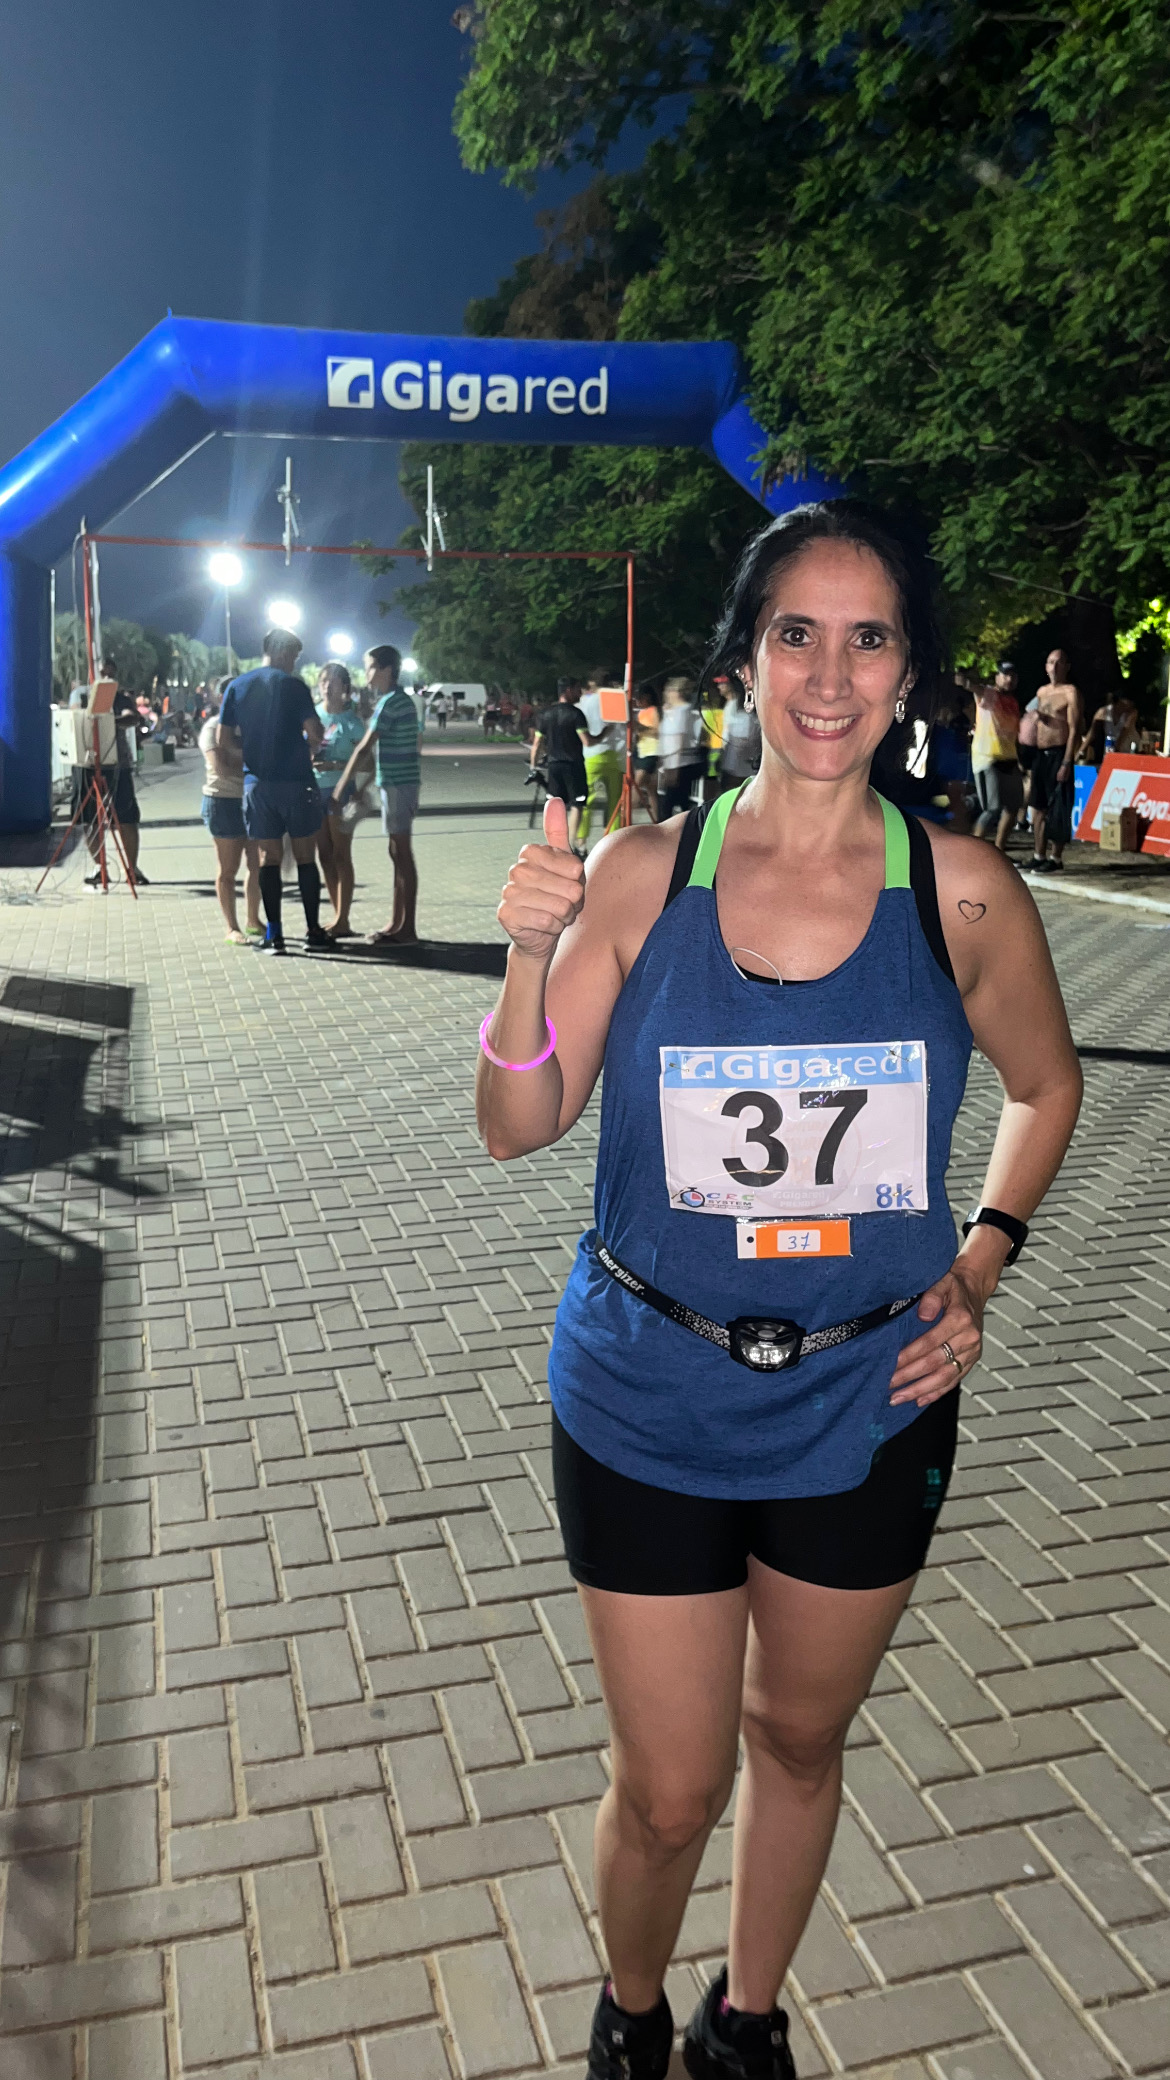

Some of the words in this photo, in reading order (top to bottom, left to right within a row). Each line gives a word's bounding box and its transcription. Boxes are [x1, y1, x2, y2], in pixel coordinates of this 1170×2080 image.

[381, 360, 608, 422] Gigared
[721, 1048, 903, 1085] Gigared
[721, 1089, 868, 1187] 37
[876, 1183, 914, 1208] 8k
[788, 1232, 810, 1250] 37
[598, 1248, 645, 1293] Energizer
